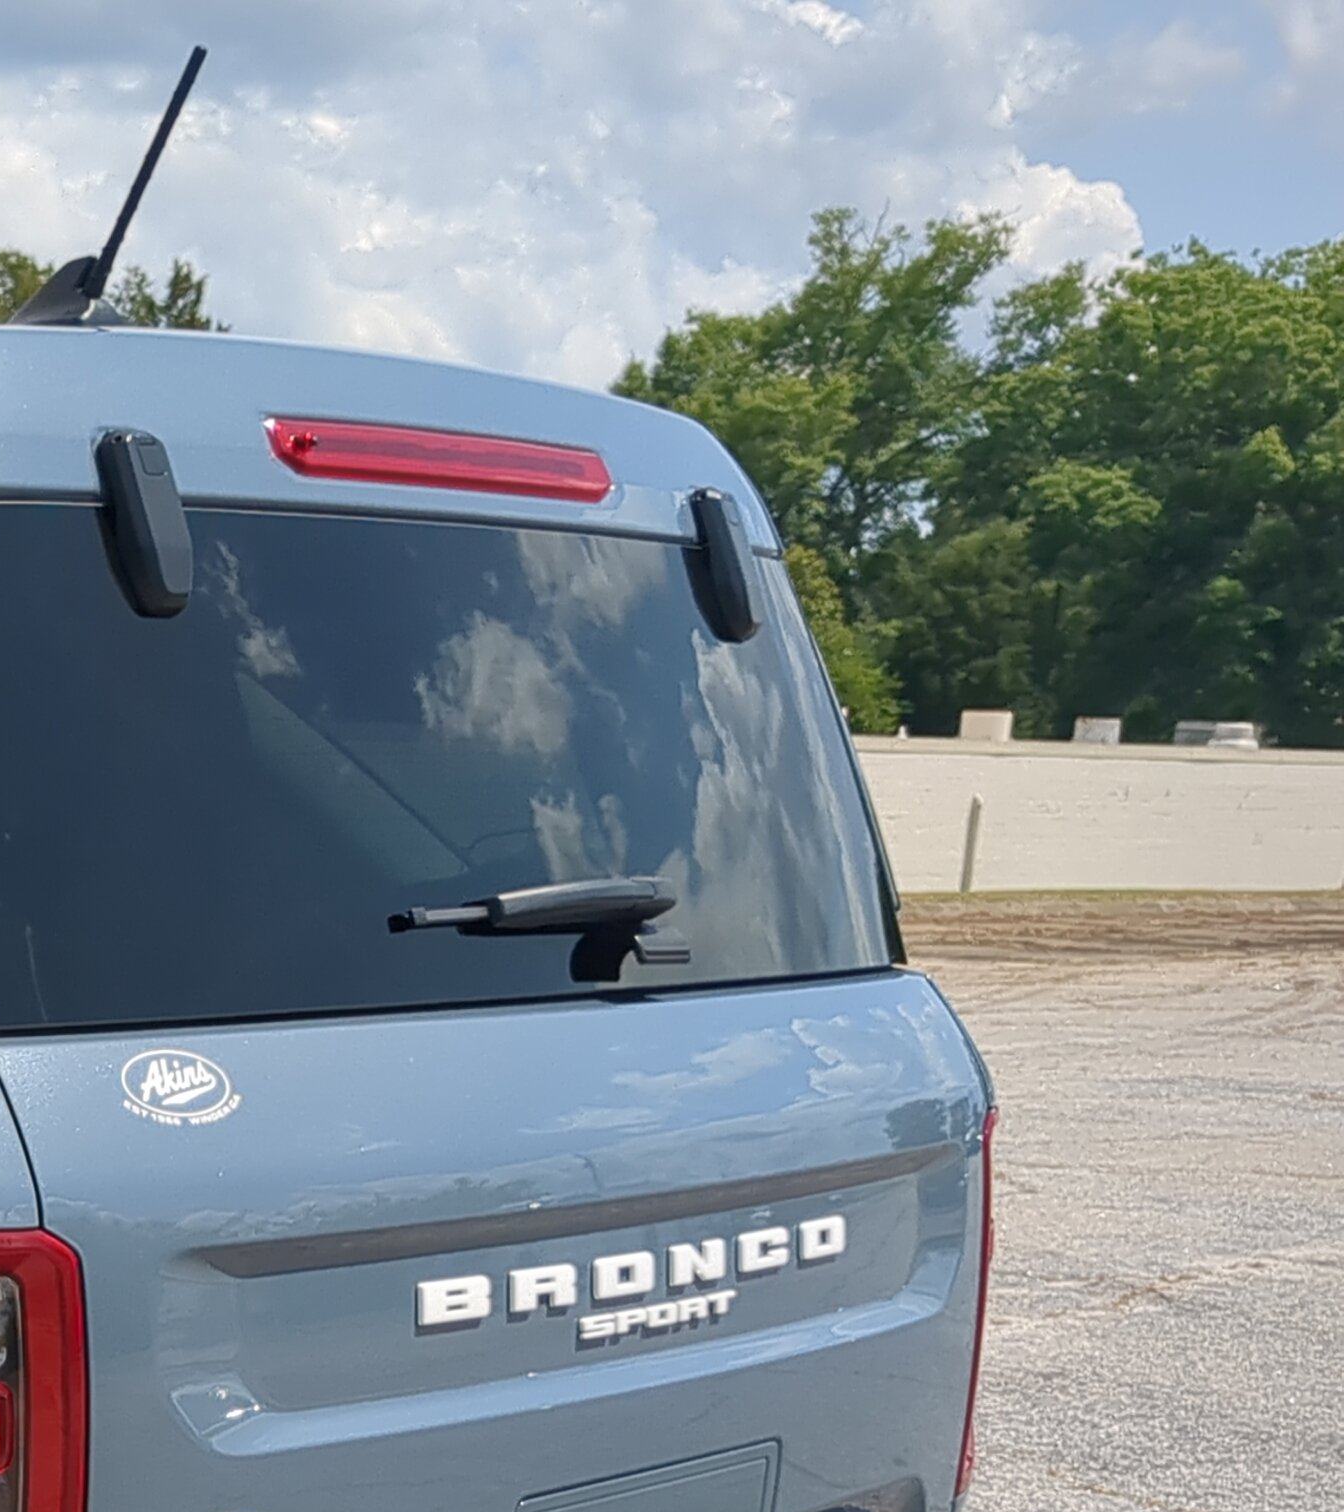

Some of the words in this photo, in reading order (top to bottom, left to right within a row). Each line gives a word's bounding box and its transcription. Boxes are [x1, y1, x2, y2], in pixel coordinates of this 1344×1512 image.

[141, 1058, 216, 1105] Akins
[417, 1215, 847, 1328] BRONCO
[578, 1290, 738, 1341] SPORT
